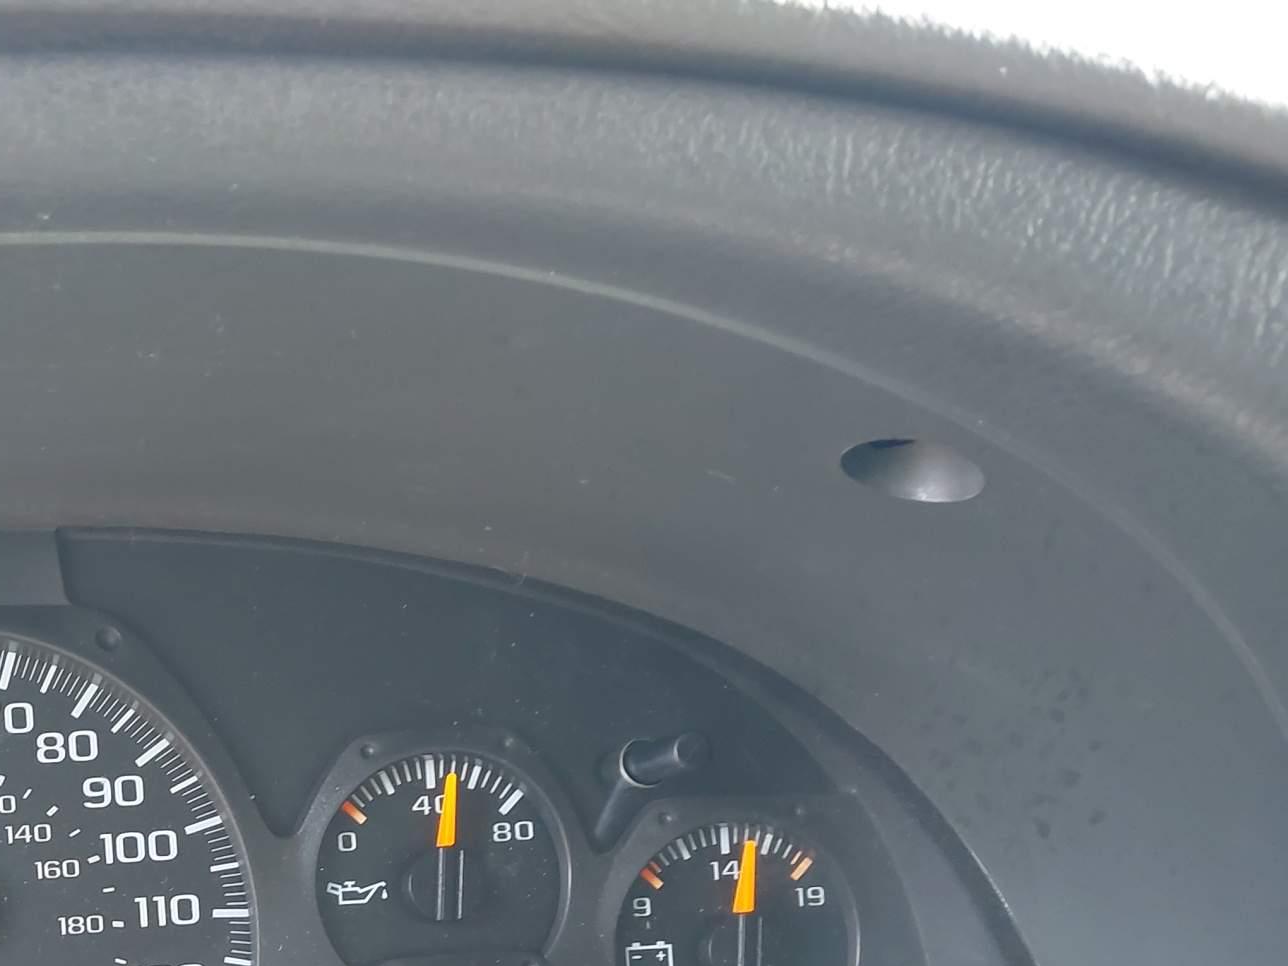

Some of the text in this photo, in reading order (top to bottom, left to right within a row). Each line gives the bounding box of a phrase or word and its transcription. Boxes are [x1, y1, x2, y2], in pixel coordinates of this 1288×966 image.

[37, 731, 98, 763] 80
[83, 776, 143, 808] 90
[5, 824, 51, 844] 140
[494, 821, 533, 841] 80
[99, 831, 178, 864] 100
[339, 832, 356, 851] 0
[35, 860, 79, 879] 160
[711, 861, 739, 880] 14
[795, 887, 824, 906] 19
[135, 895, 199, 927] 110
[634, 898, 651, 916] 9
[58, 916, 103, 935] 180
